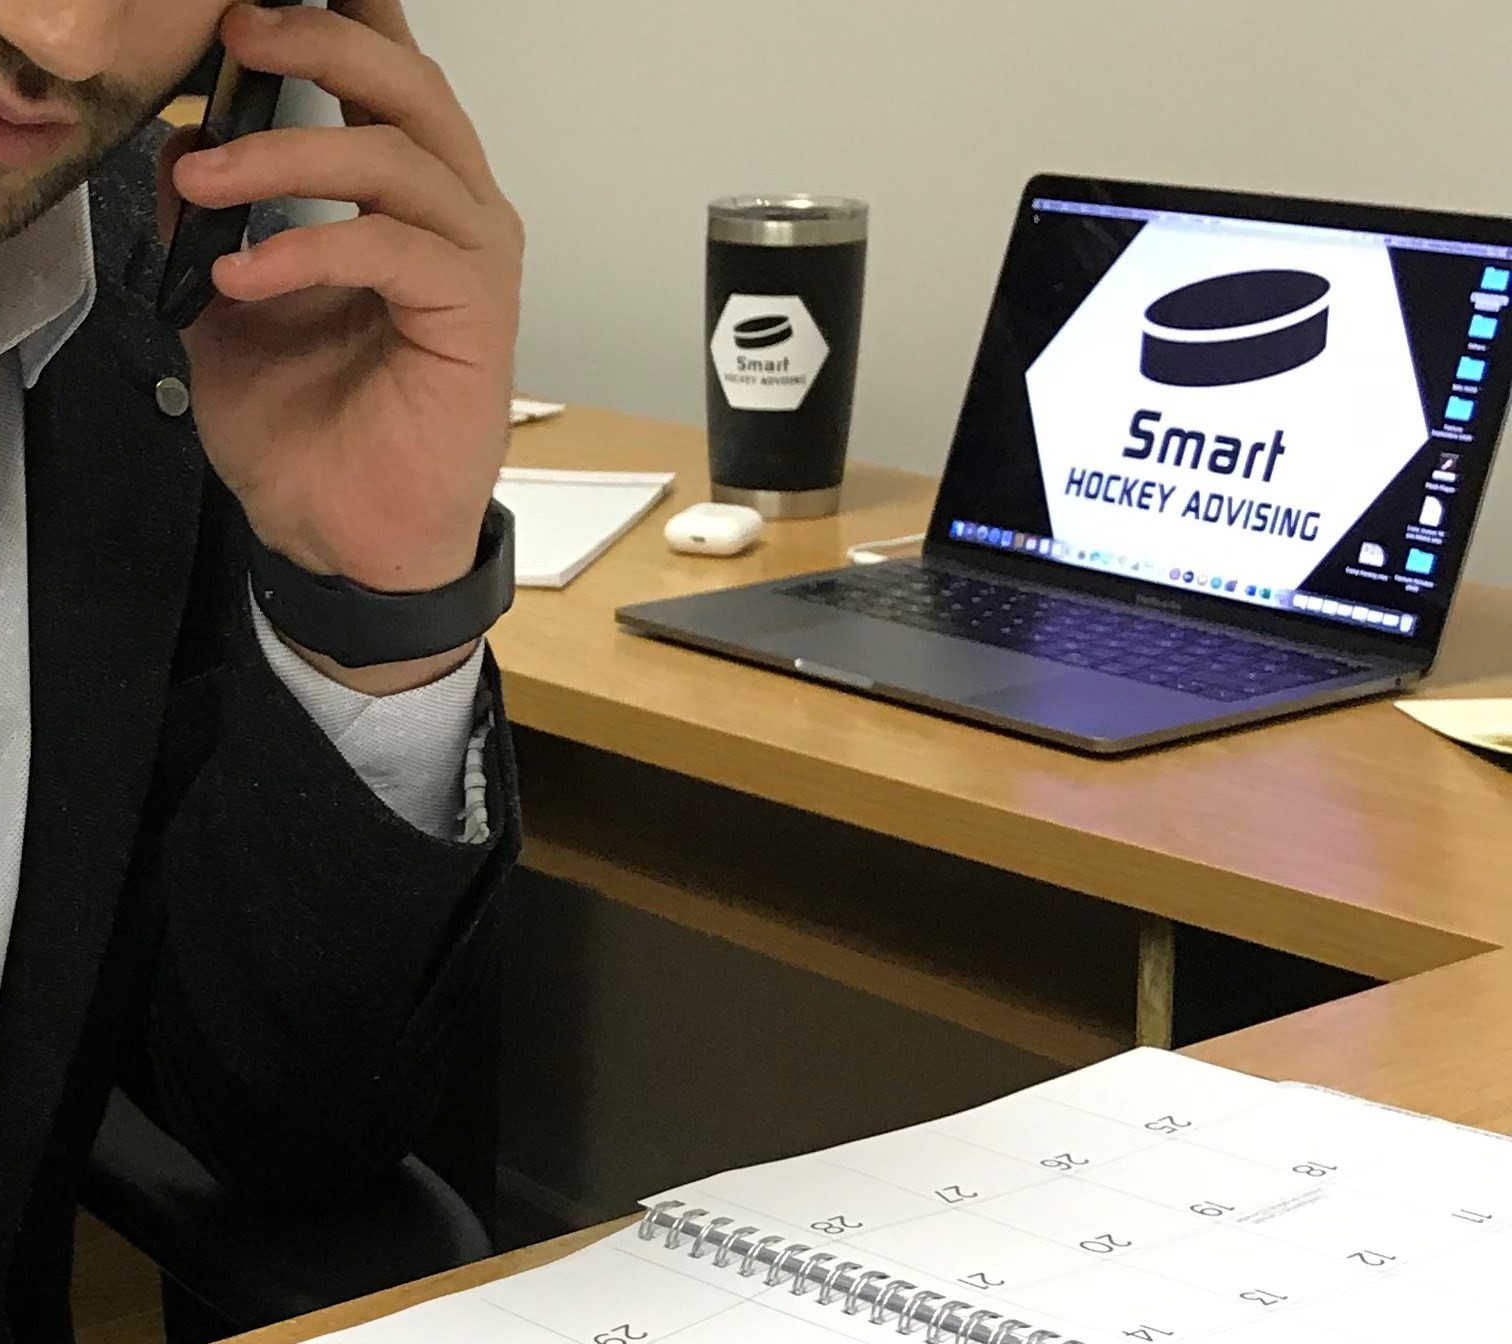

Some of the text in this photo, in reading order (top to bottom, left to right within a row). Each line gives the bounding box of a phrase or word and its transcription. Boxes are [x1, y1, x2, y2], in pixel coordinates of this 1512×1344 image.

[736, 355, 790, 372] Smart
[1122, 409, 1286, 483] Smart
[1065, 467, 1321, 542] HOCKEY ADVISING
[1143, 1115, 1192, 1134] 25
[1039, 1152, 1089, 1171] 26
[1292, 1161, 1338, 1177] 18
[934, 1185, 979, 1205] 27
[1189, 1200, 1236, 1217] 19
[1451, 1209, 1493, 1224] 11
[809, 1215, 863, 1235] 28
[1078, 1233, 1132, 1254] 20
[1346, 1249, 1396, 1266] 12
[957, 1272, 1005, 1290] 21
[1239, 1289, 1288, 1306] 13
[1122, 1324, 1174, 1343] 14
